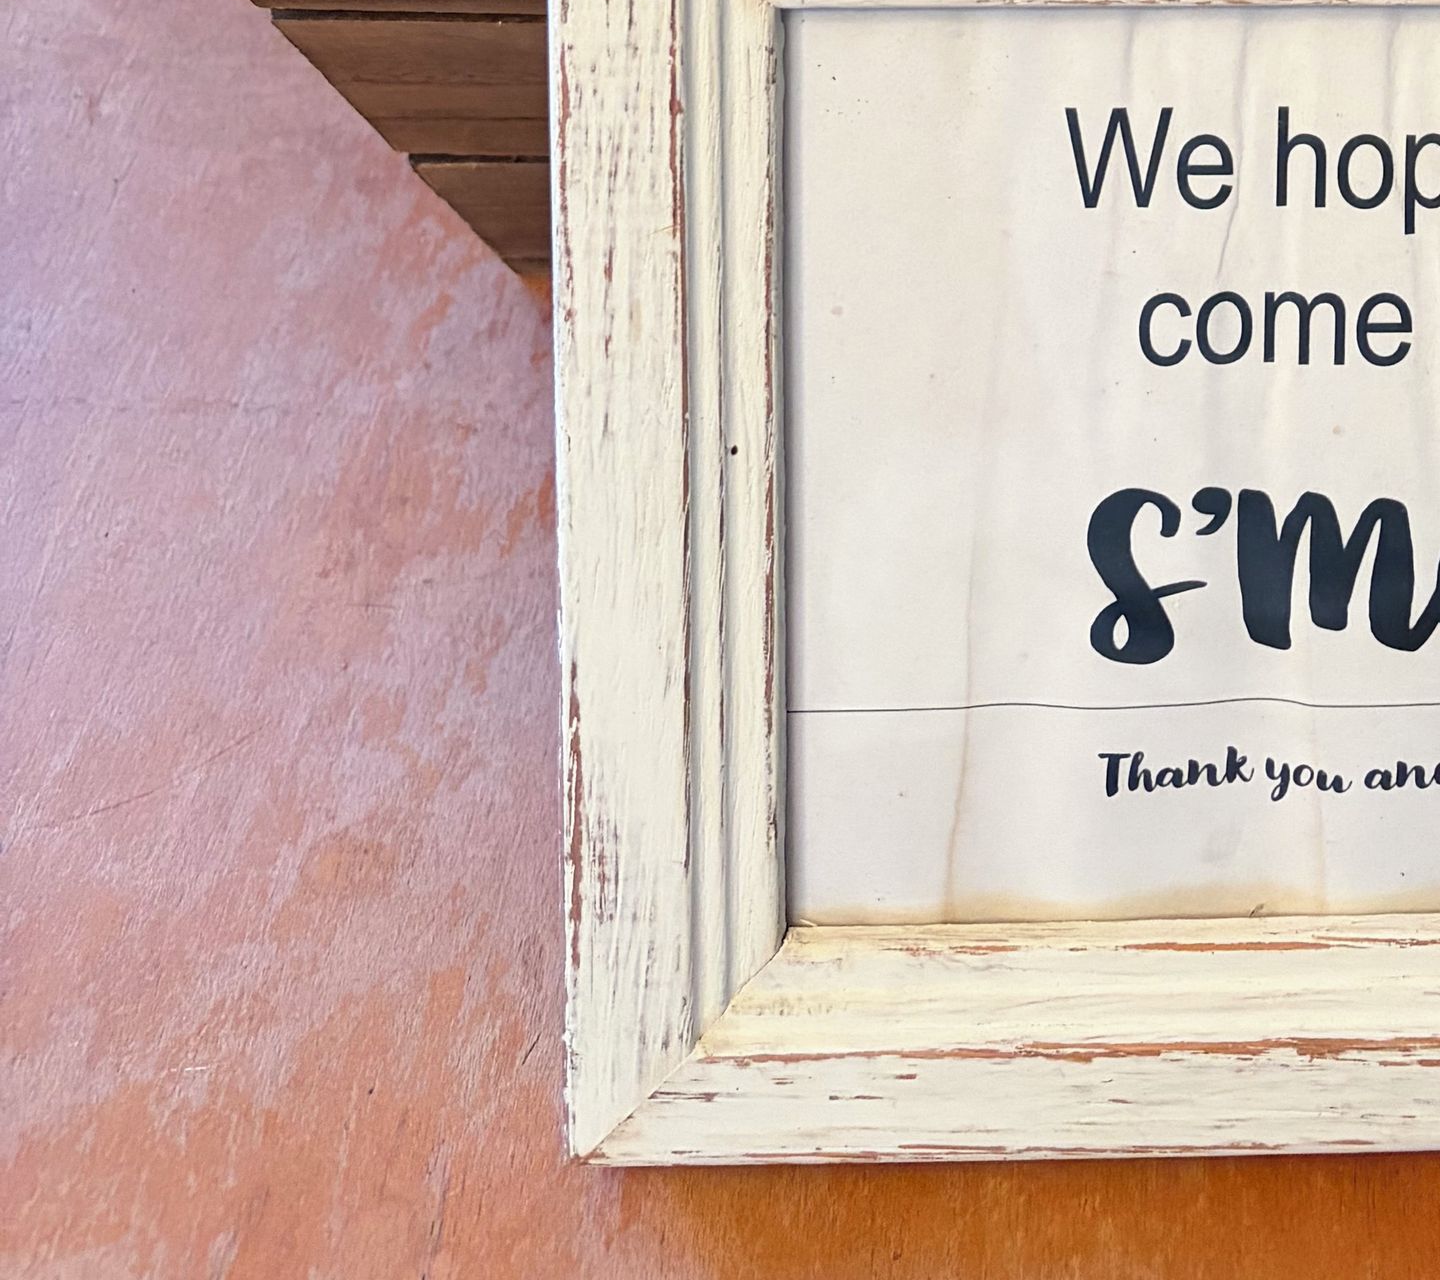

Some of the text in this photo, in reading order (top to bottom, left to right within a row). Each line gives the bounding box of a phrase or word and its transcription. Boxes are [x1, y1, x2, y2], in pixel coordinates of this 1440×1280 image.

[1065, 107, 1234, 210] We
[1138, 290, 1413, 367] come
[1098, 746, 1255, 798] Thank
[1264, 757, 1352, 802] you
